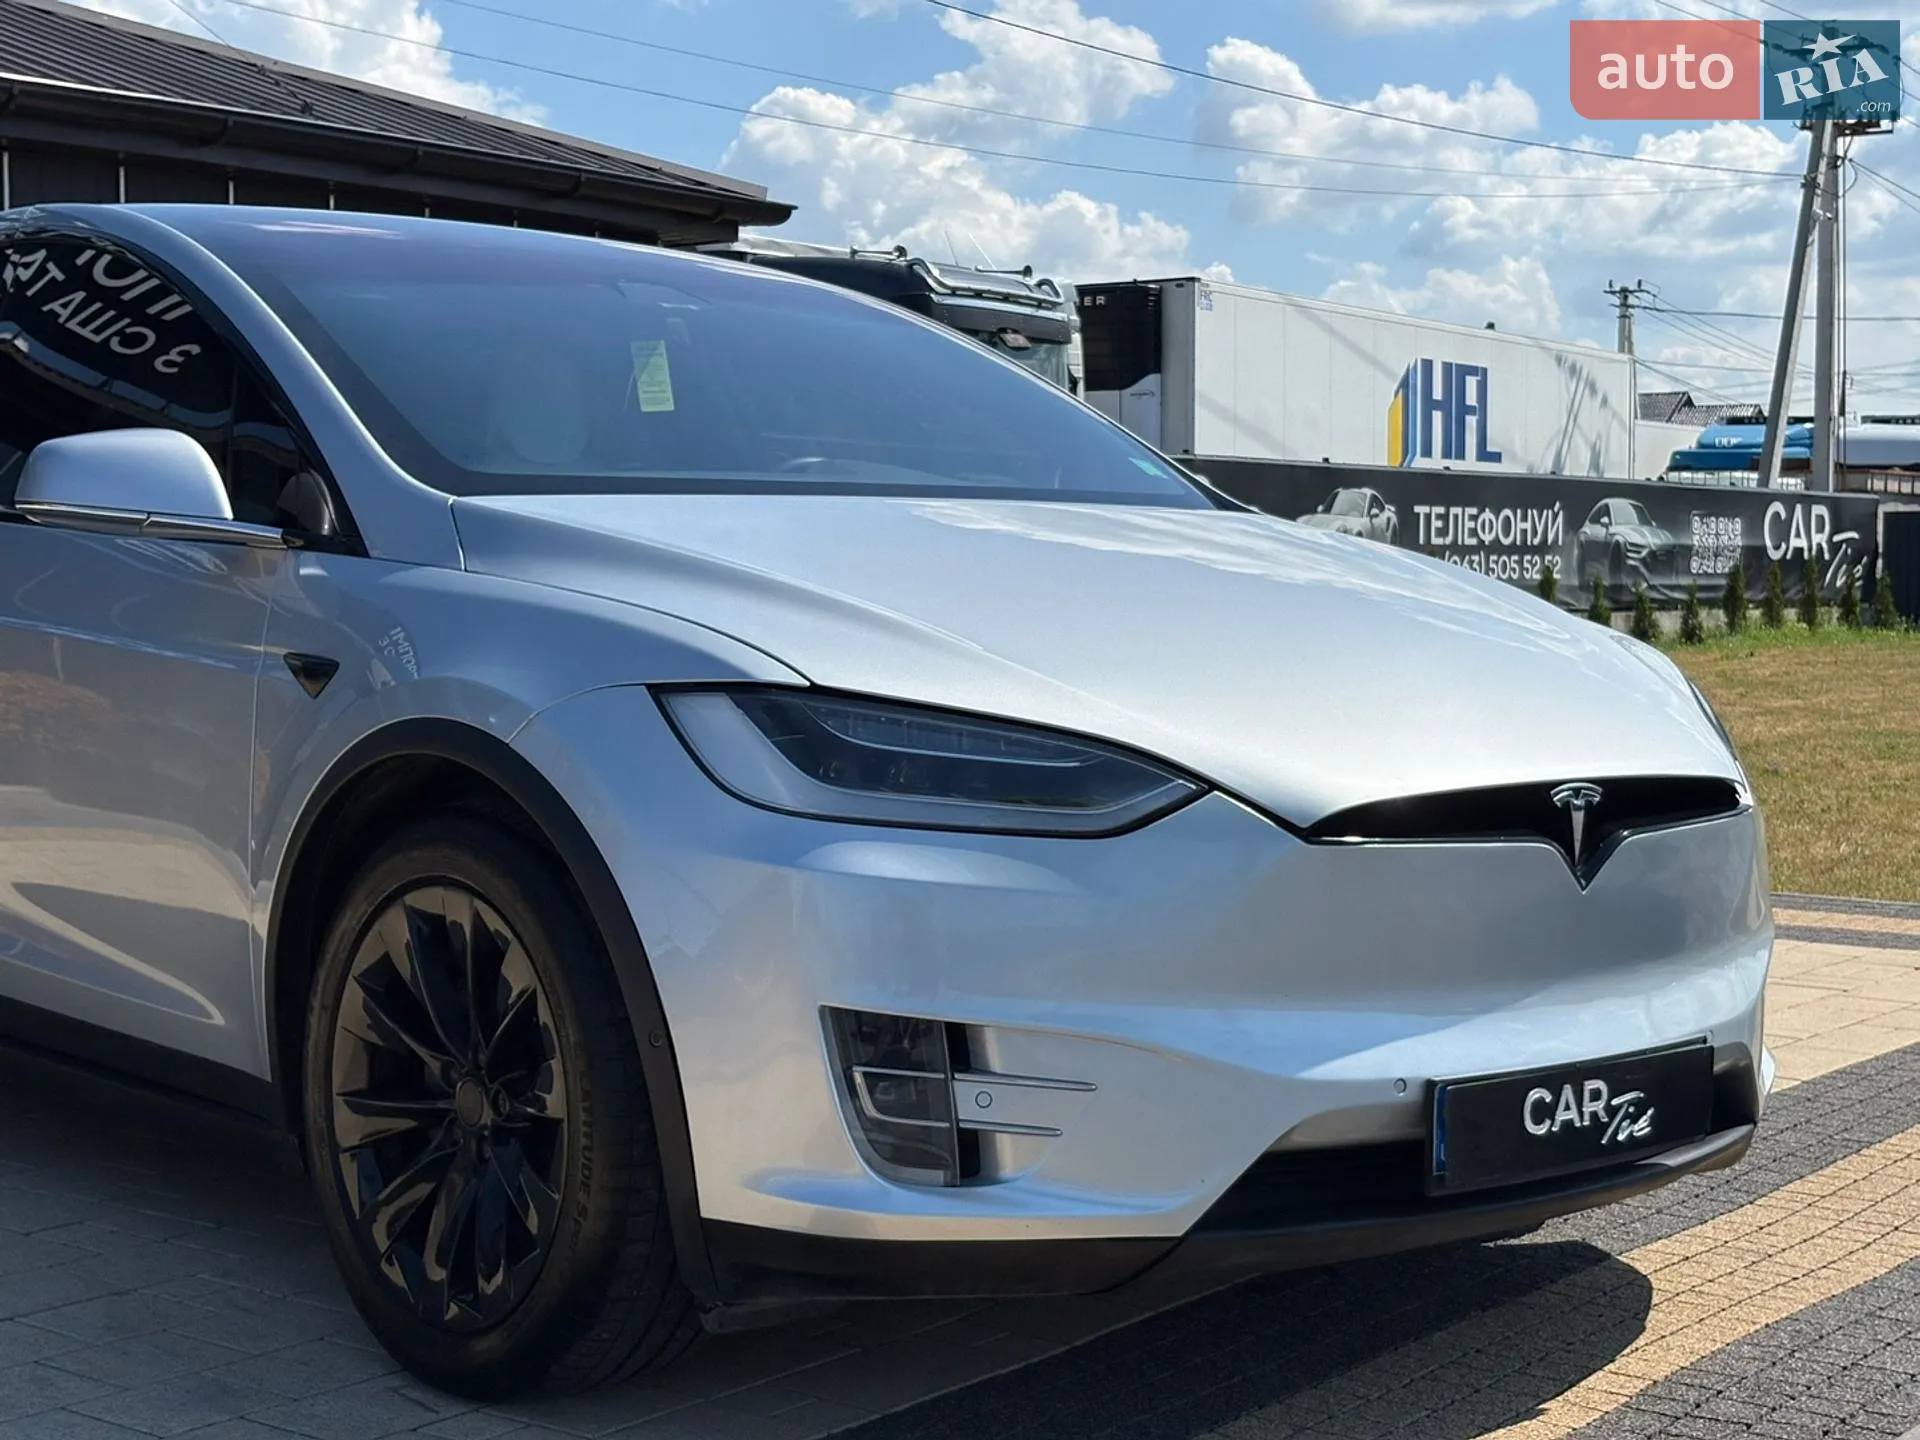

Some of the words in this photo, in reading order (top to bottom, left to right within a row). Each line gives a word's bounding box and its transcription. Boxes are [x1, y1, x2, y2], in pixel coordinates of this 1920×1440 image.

[1419, 357, 1502, 463] HFL
[1413, 500, 1564, 546] ТЕЛЕФОНУЙ
[1763, 501, 1830, 560] CAR
[1488, 555, 1519, 579] 505
[1523, 555, 1541, 579] 52
[1523, 1079, 1608, 1135] CAR
